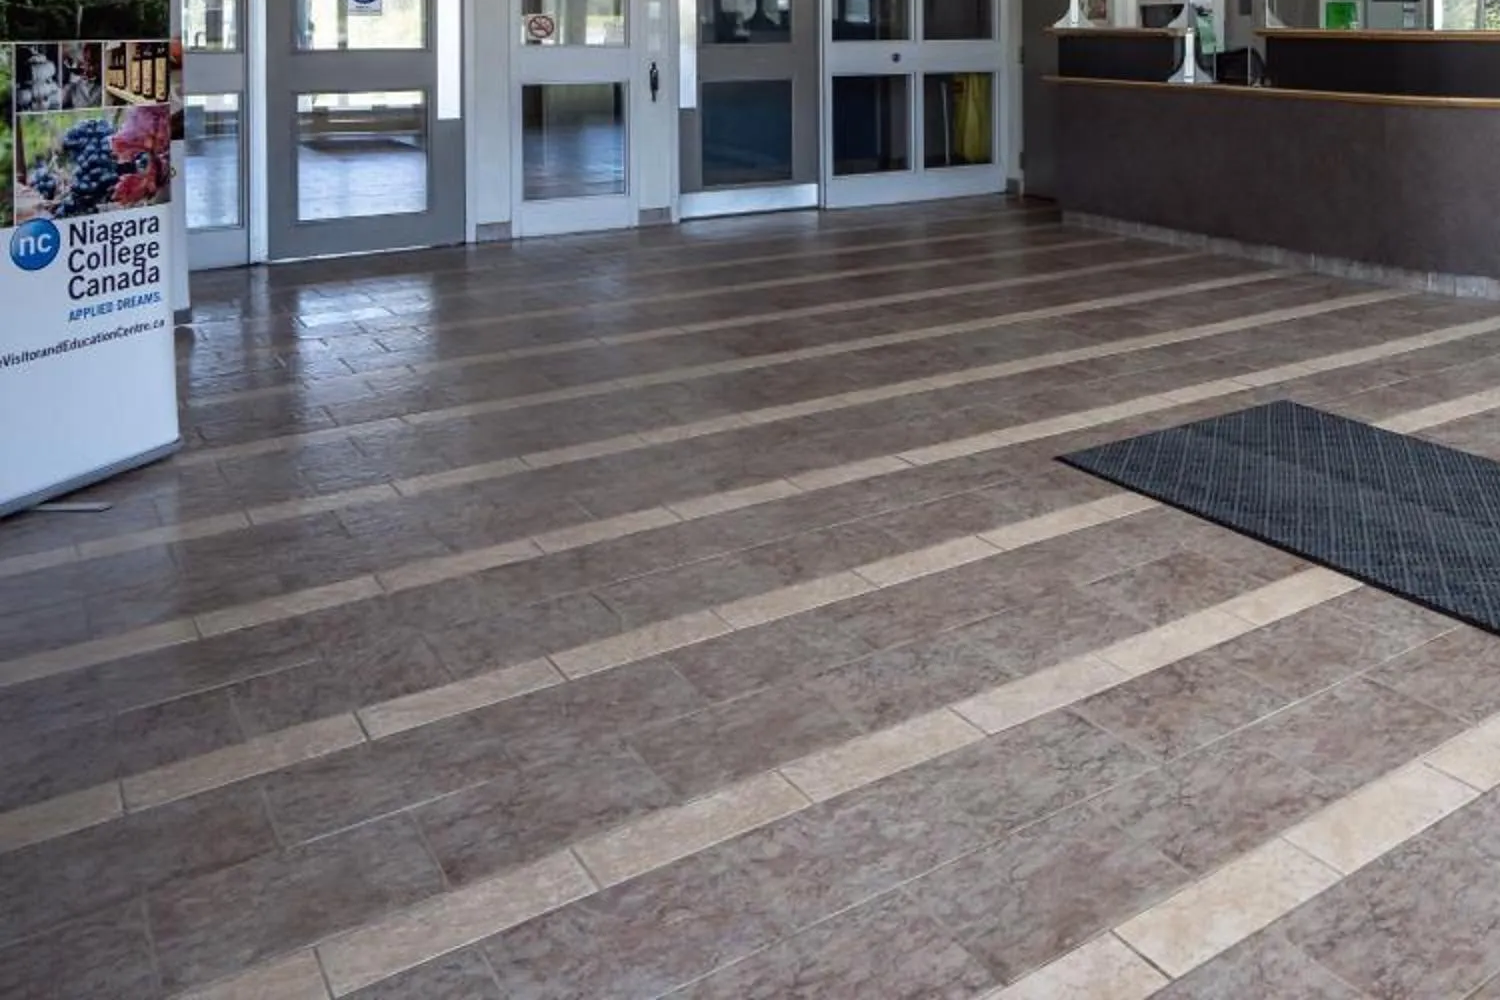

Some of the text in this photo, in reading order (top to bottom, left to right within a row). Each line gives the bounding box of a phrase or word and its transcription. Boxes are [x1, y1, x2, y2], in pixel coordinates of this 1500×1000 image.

[19, 233, 52, 256] nc
[69, 215, 160, 247] Niagara
[68, 240, 160, 273] College
[68, 261, 160, 300] Canada
[68, 304, 113, 322] APPLIED
